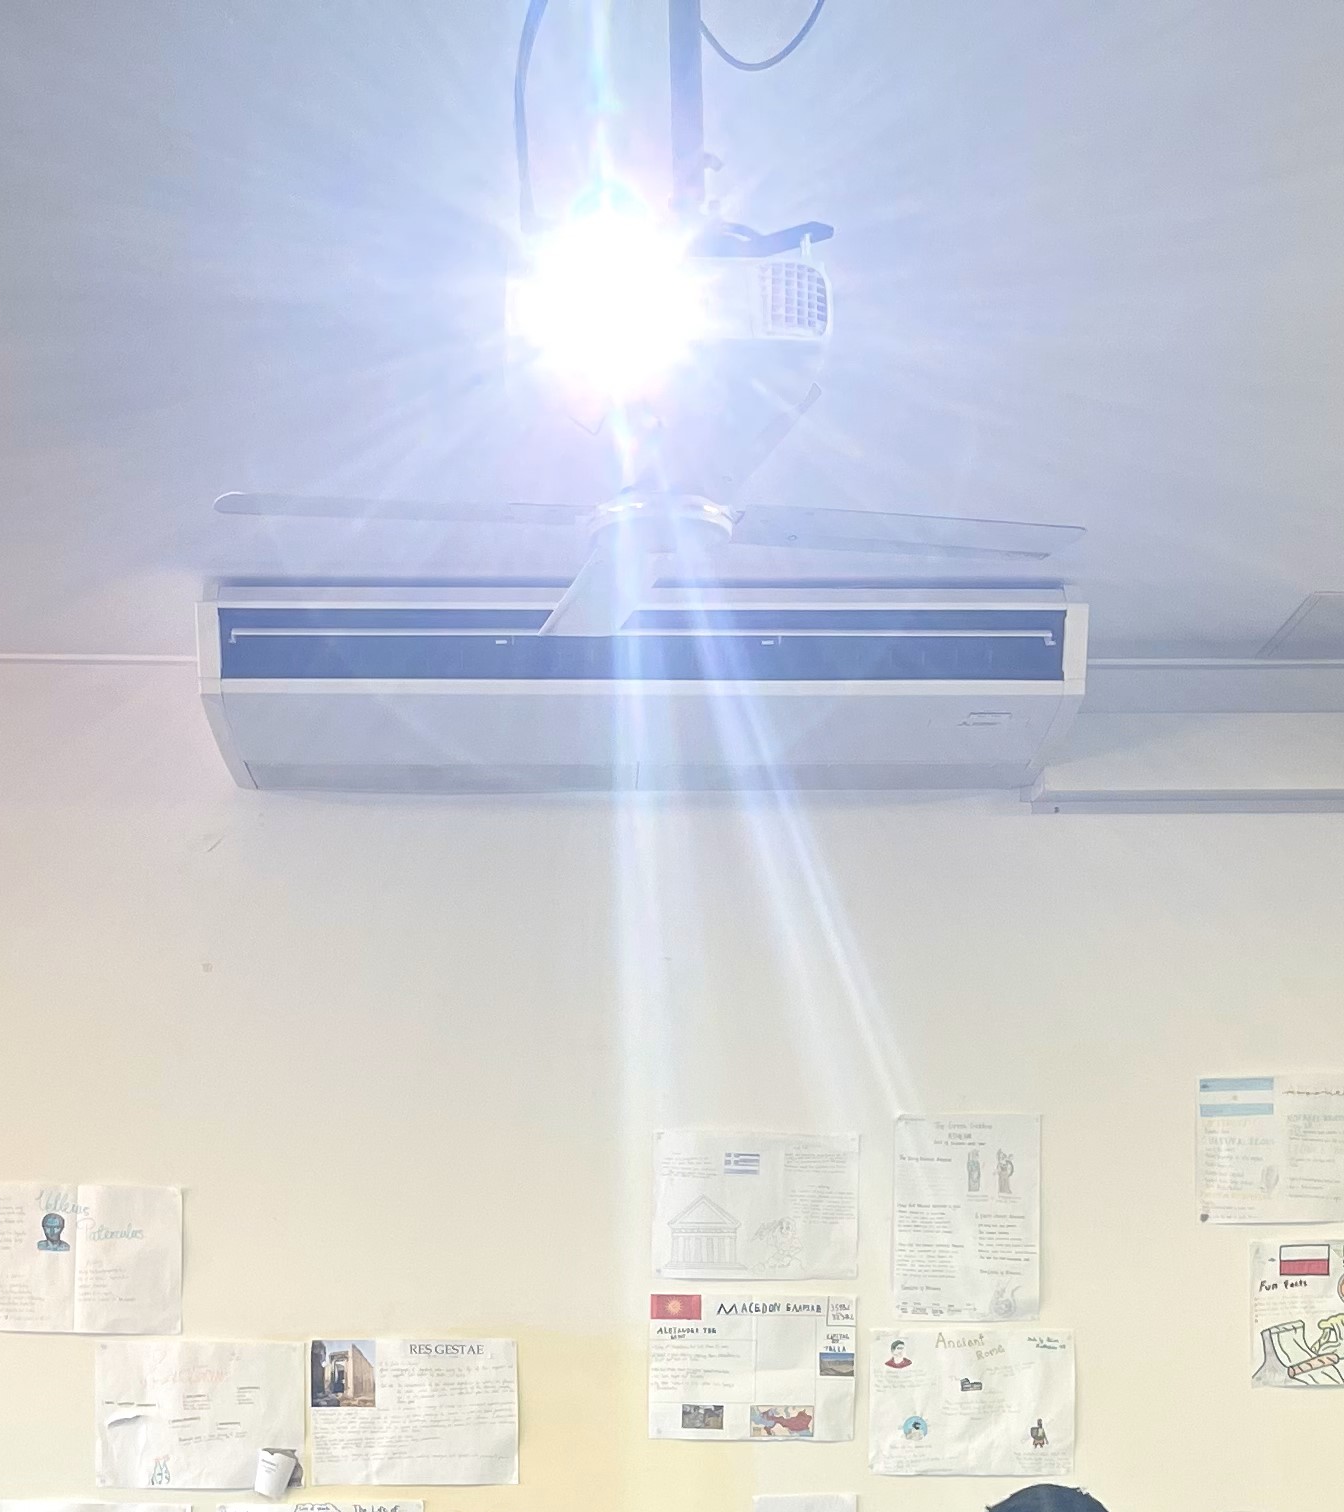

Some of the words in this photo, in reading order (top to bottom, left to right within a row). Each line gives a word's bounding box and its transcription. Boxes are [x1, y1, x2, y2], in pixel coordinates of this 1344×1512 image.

[1259, 1280, 1278, 1292] Fun
[716, 1303, 782, 1315] MACEDON
[409, 1343, 432, 1355] RES
[434, 1343, 485, 1355] GESTAE
